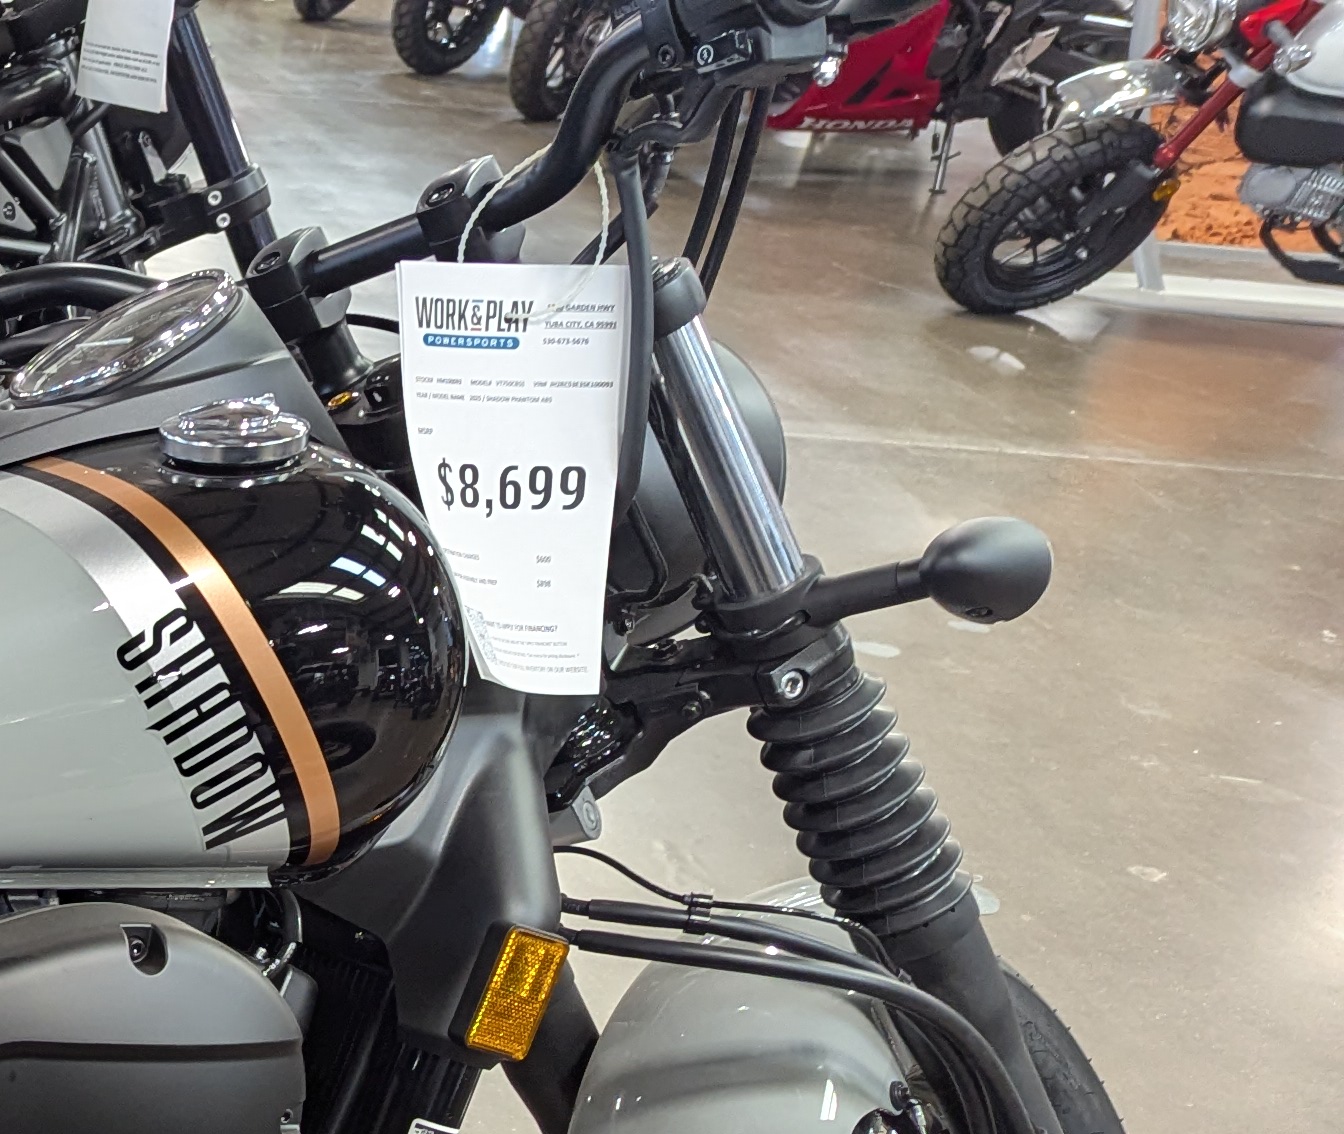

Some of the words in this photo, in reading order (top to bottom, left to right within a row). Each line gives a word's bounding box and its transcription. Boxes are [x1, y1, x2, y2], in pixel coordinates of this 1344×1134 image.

[797, 116, 914, 130] HONDA
[415, 296, 470, 331] WORK
[485, 299, 534, 332] PLAY
[427, 336, 514, 348] POWERSPORTS
[437, 457, 587, 518] $8,699
[116, 607, 287, 852] SHADOW
